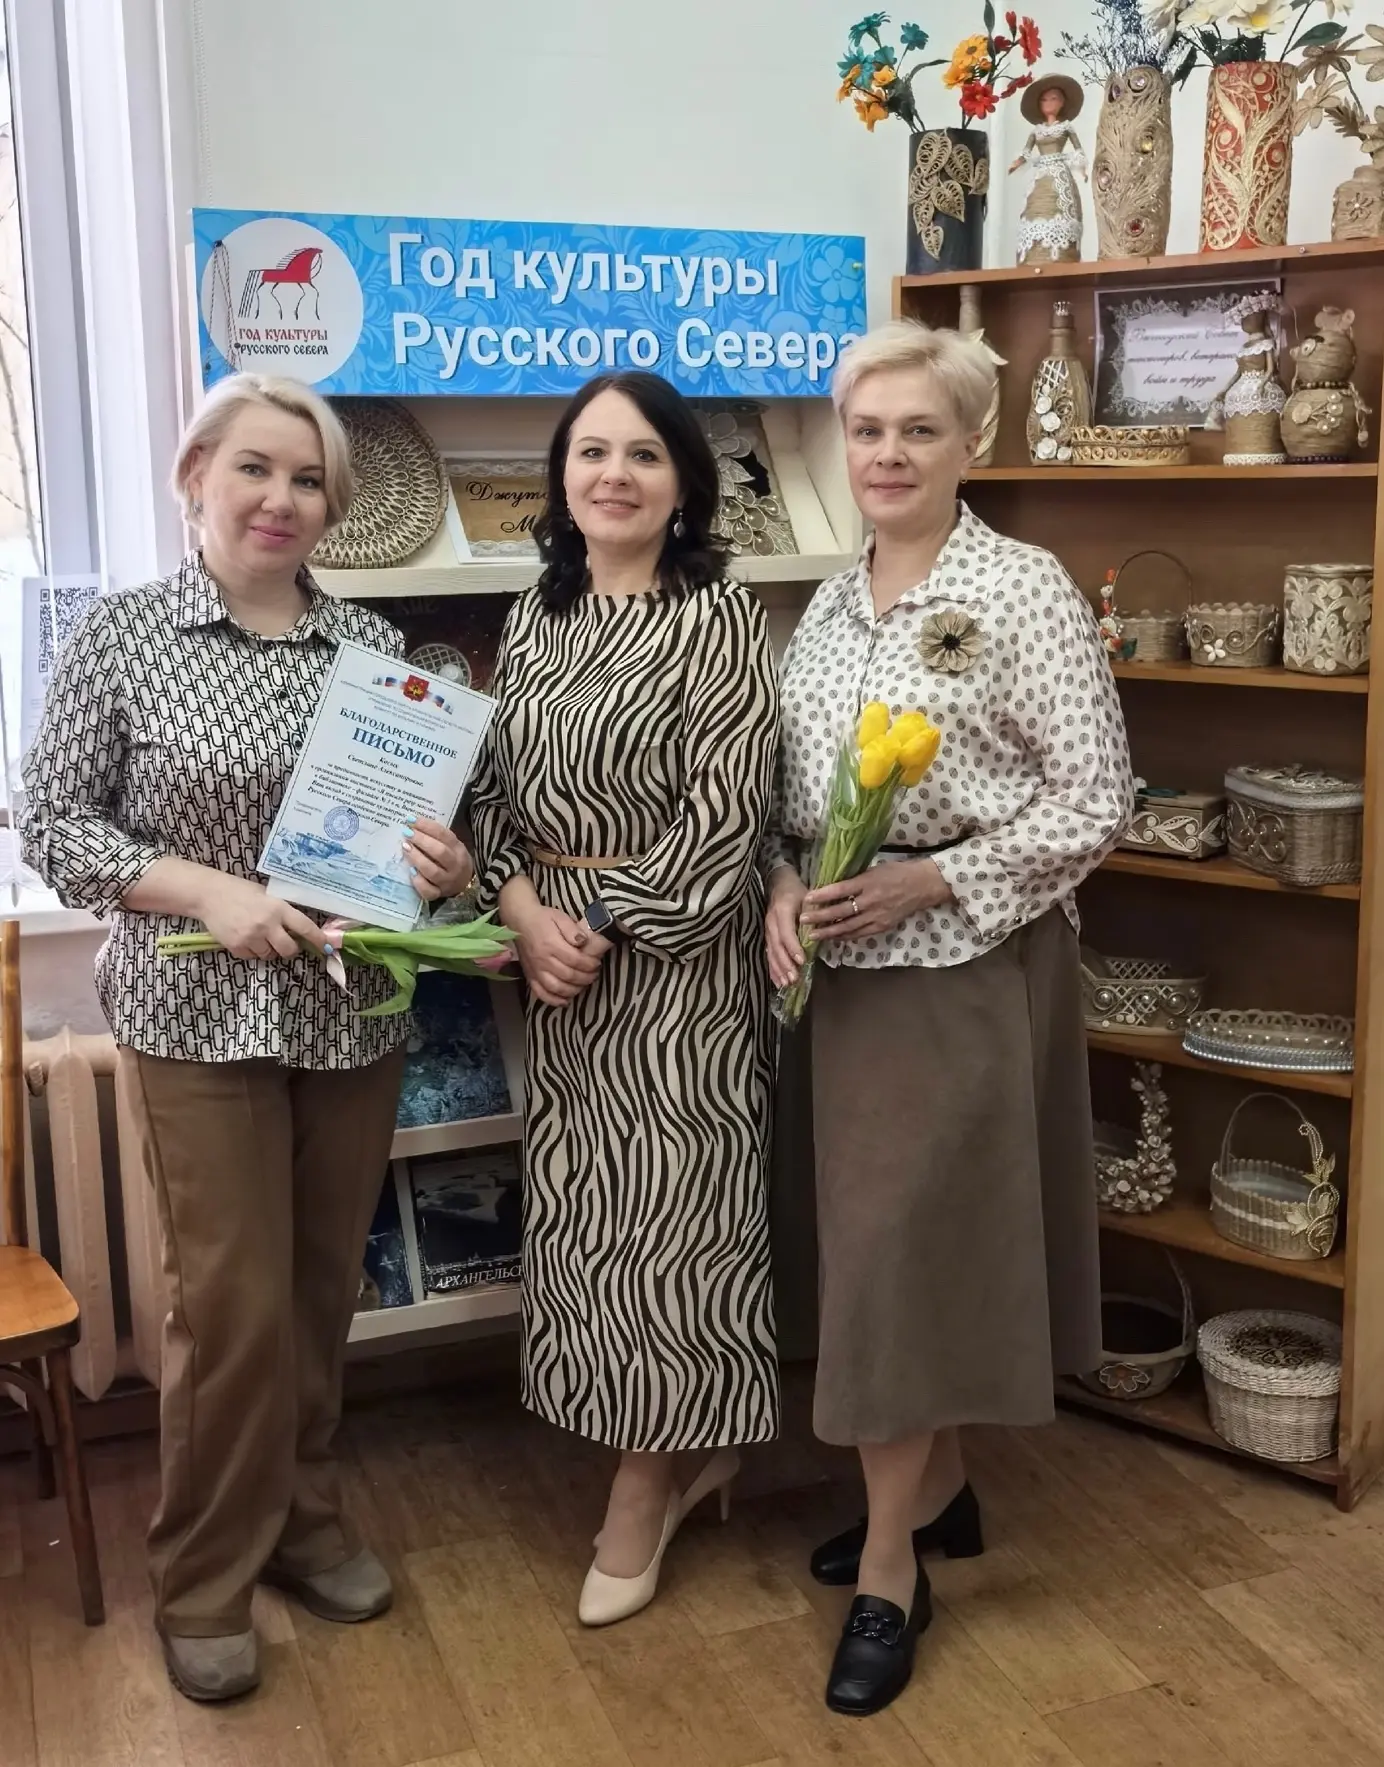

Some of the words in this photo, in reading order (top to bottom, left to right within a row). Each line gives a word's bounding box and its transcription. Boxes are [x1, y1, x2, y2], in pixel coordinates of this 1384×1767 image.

[389, 232, 497, 299] Год
[513, 249, 780, 307] культуры
[238, 328, 262, 341] ГОД
[264, 328, 329, 343] КУЛЬТУРЫ
[239, 342, 292, 356] РУССКОГО
[292, 344, 329, 356] СЕВЕРА
[393, 311, 661, 380] Русского
[339, 706, 458, 759] БЛАГОДАРСТВЕННОЕ
[351, 726, 436, 769] ПИСЬМО
